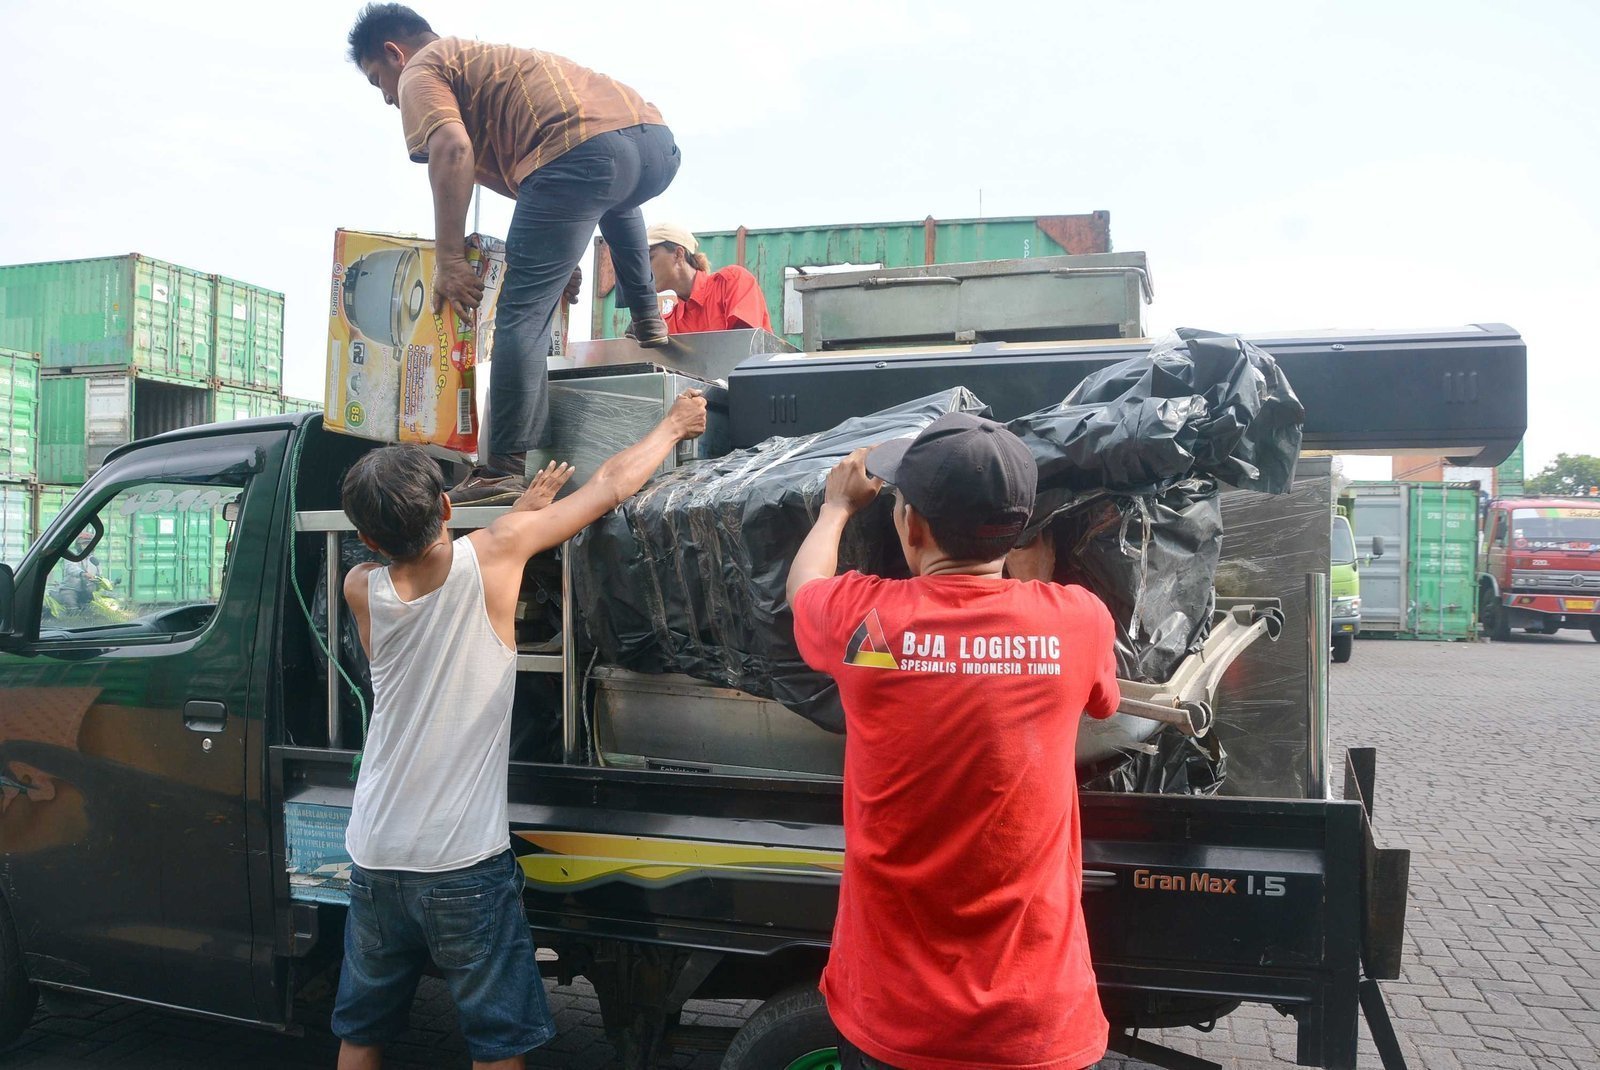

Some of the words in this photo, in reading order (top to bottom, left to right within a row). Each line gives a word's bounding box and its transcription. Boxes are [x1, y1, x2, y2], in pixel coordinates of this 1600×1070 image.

[439, 333, 449, 371] Nasi
[435, 374, 447, 398] Ga
[351, 406, 360, 422] 85
[902, 631, 945, 659] BJA
[959, 635, 1061, 660] LOGISTIC
[900, 658, 957, 674] SPESIALIS
[962, 661, 1022, 675] INDONESIA
[1027, 663, 1061, 675] TIMUR
[1133, 869, 1186, 891] Gran
[1190, 872, 1237, 894] Max
[1247, 875, 1287, 897] 1.5
